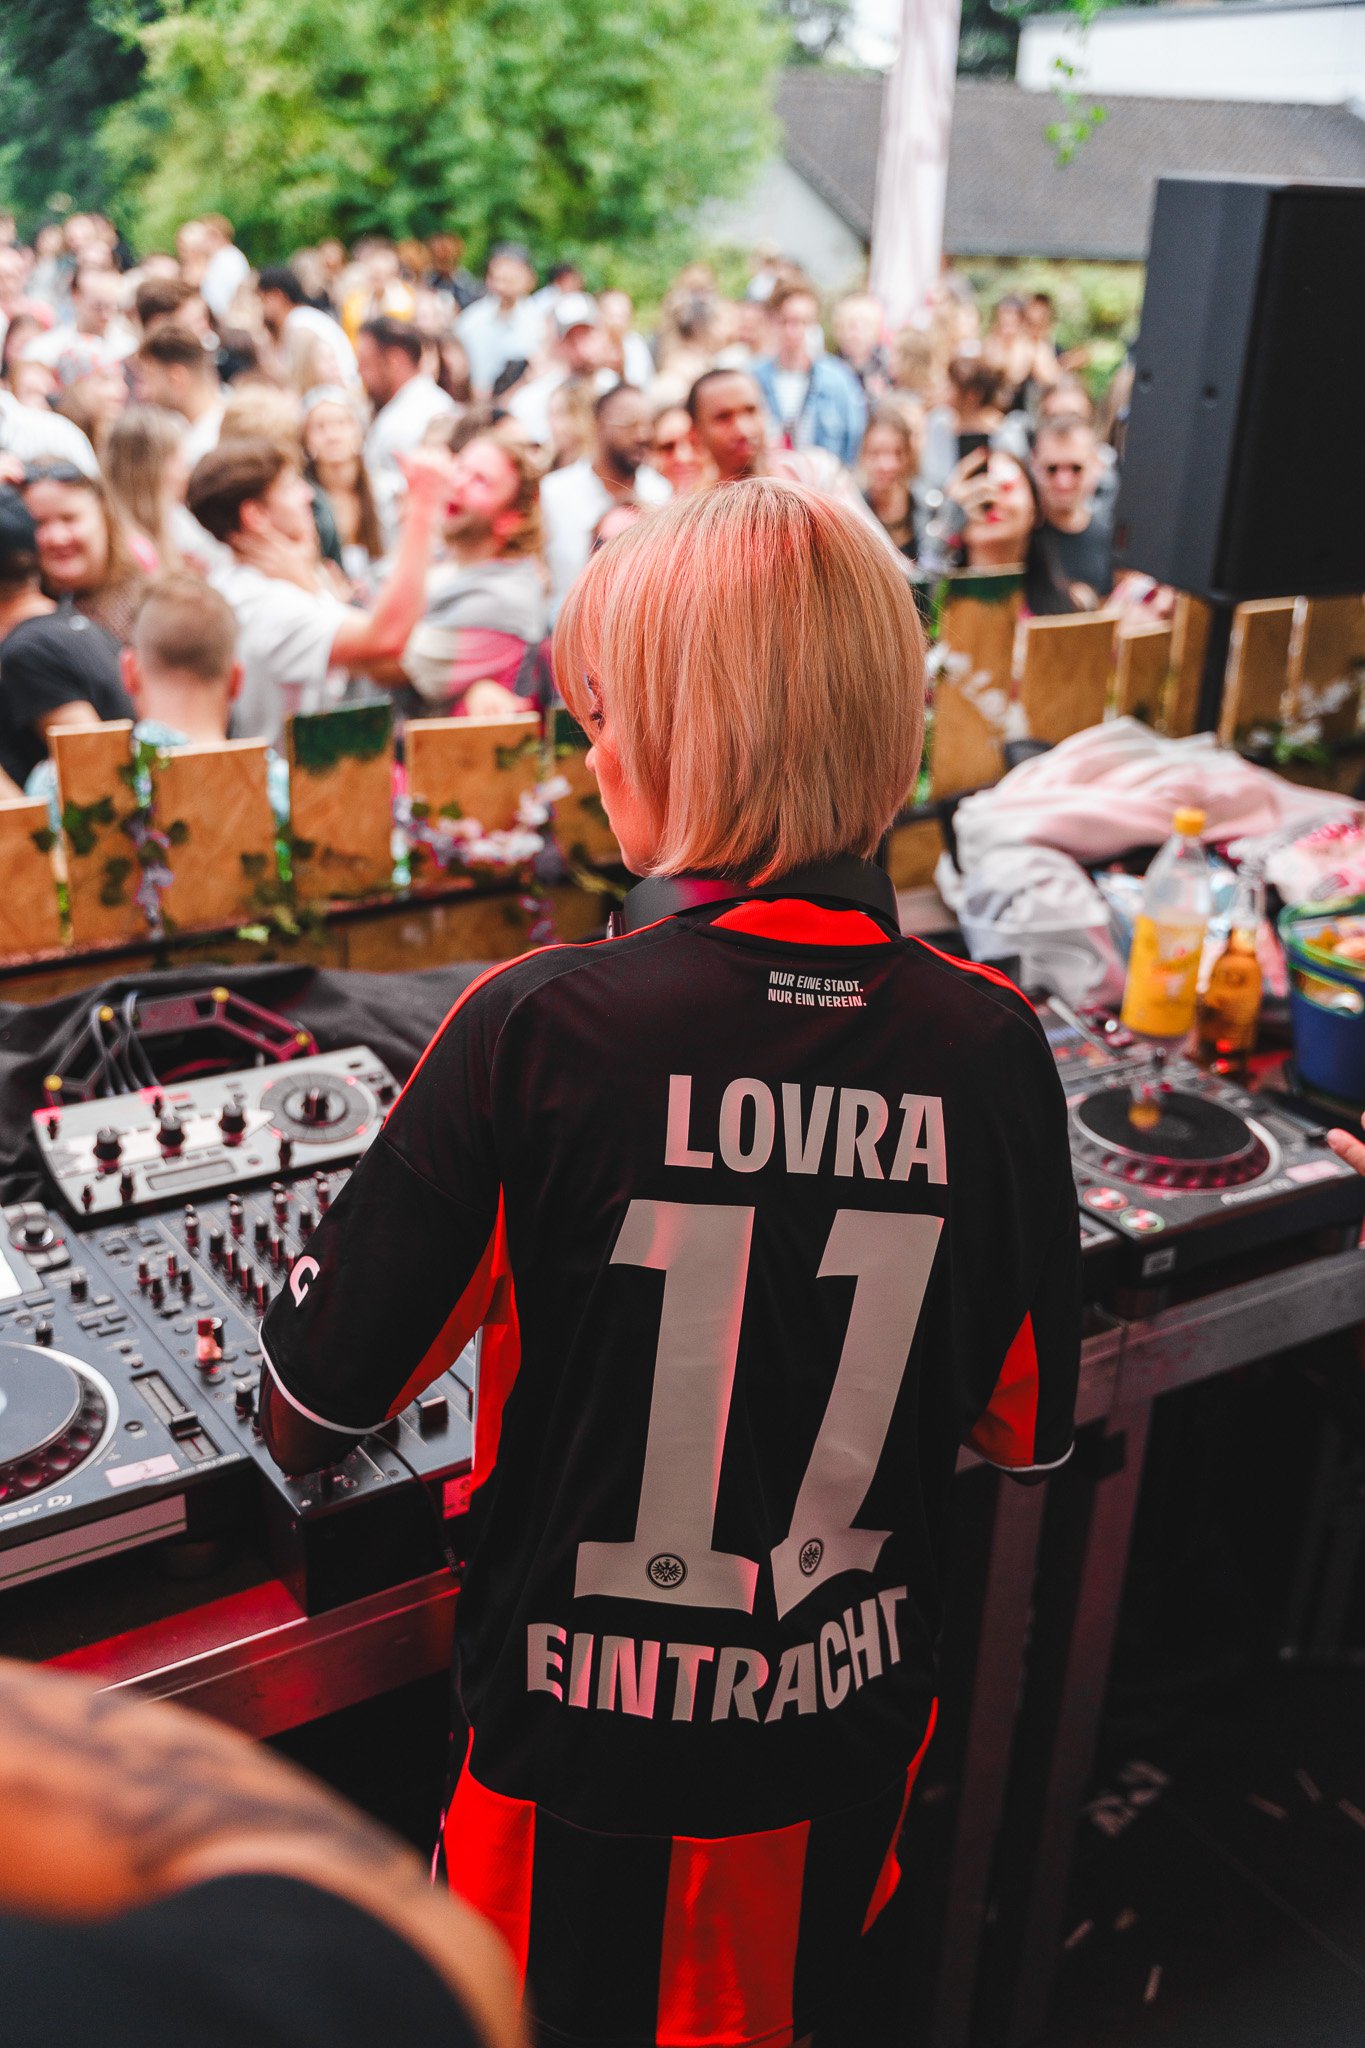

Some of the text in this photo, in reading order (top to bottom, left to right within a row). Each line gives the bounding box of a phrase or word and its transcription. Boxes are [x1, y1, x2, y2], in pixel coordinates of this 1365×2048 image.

[768, 988, 867, 1008] NUR EIN VEREIN.
[769, 971, 864, 992] NUR EINE STADT.
[664, 1074, 948, 1185] LOVRA
[527, 1585, 908, 1724] EINTRACHT
